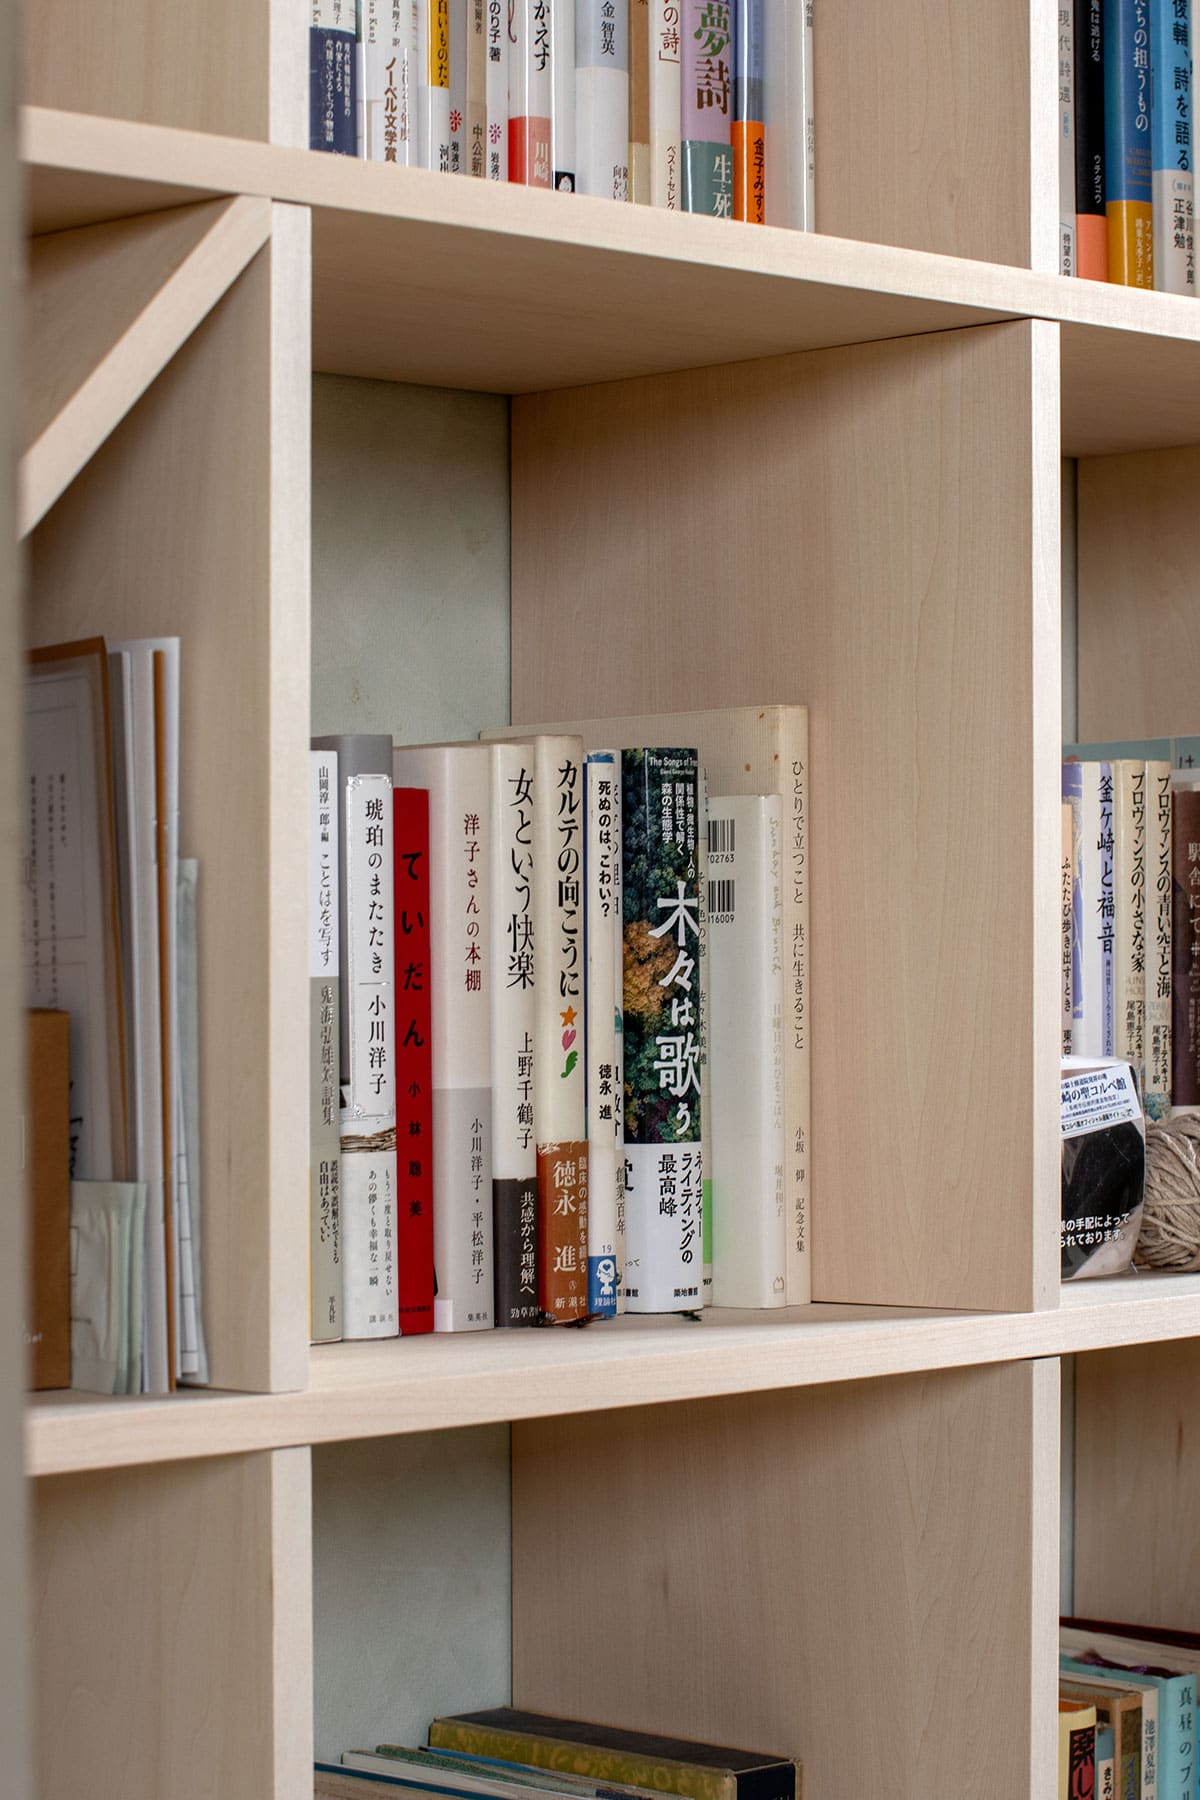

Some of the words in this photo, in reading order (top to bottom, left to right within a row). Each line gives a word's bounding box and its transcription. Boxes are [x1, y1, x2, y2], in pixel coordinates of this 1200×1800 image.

[437, 0, 449, 86] 白いものた
[659, 0, 681, 64] の詩」
[384, 56, 398, 163] ノーベル文学賞
[471, 123, 483, 178] 中公新
[712, 153, 732, 218] 生と死
[1174, 198, 1186, 250] 正津勉
[661, 782, 674, 844] 森の生態学
[706, 854, 735, 864] 02763
[792, 761, 805, 904] ひとりで立つこと
[365, 798, 385, 975] 琥珀のまたたき
[463, 812, 482, 993] 洋子さんの本棚
[506, 767, 536, 991] 女という快楽
[557, 759, 581, 998] カルテの向こうに
[1130, 771, 1145, 973] プロヴァンスの小さな家
[1156, 774, 1171, 999] プロヴァンスの青い空と海
[401, 851, 425, 1048] ていだん
[792, 923, 805, 1050] 共に生きること
[367, 995, 387, 1095] 小川洋子
[648, 880, 701, 1136] 木々は歌う
[516, 1031, 535, 1151] 上野千鶴子
[598, 1063, 613, 1096] 徳永
[599, 1104, 613, 1121] 進
[407, 1081, 422, 1218] 小林聡美
[552, 1160, 577, 1217] 徳永
[658, 1153, 679, 1218] 最高峰
[795, 1127, 805, 1153] 小坂
[470, 1117, 484, 1286] 小川洋子・平松洋子
[520, 1191, 536, 1295] 共感から理解へ
[601, 1244, 612, 1254] 19
[679, 1152, 696, 1265] ライティングの
[795, 1198, 805, 1253] 記念文集
[552, 1245, 577, 1273] 進
